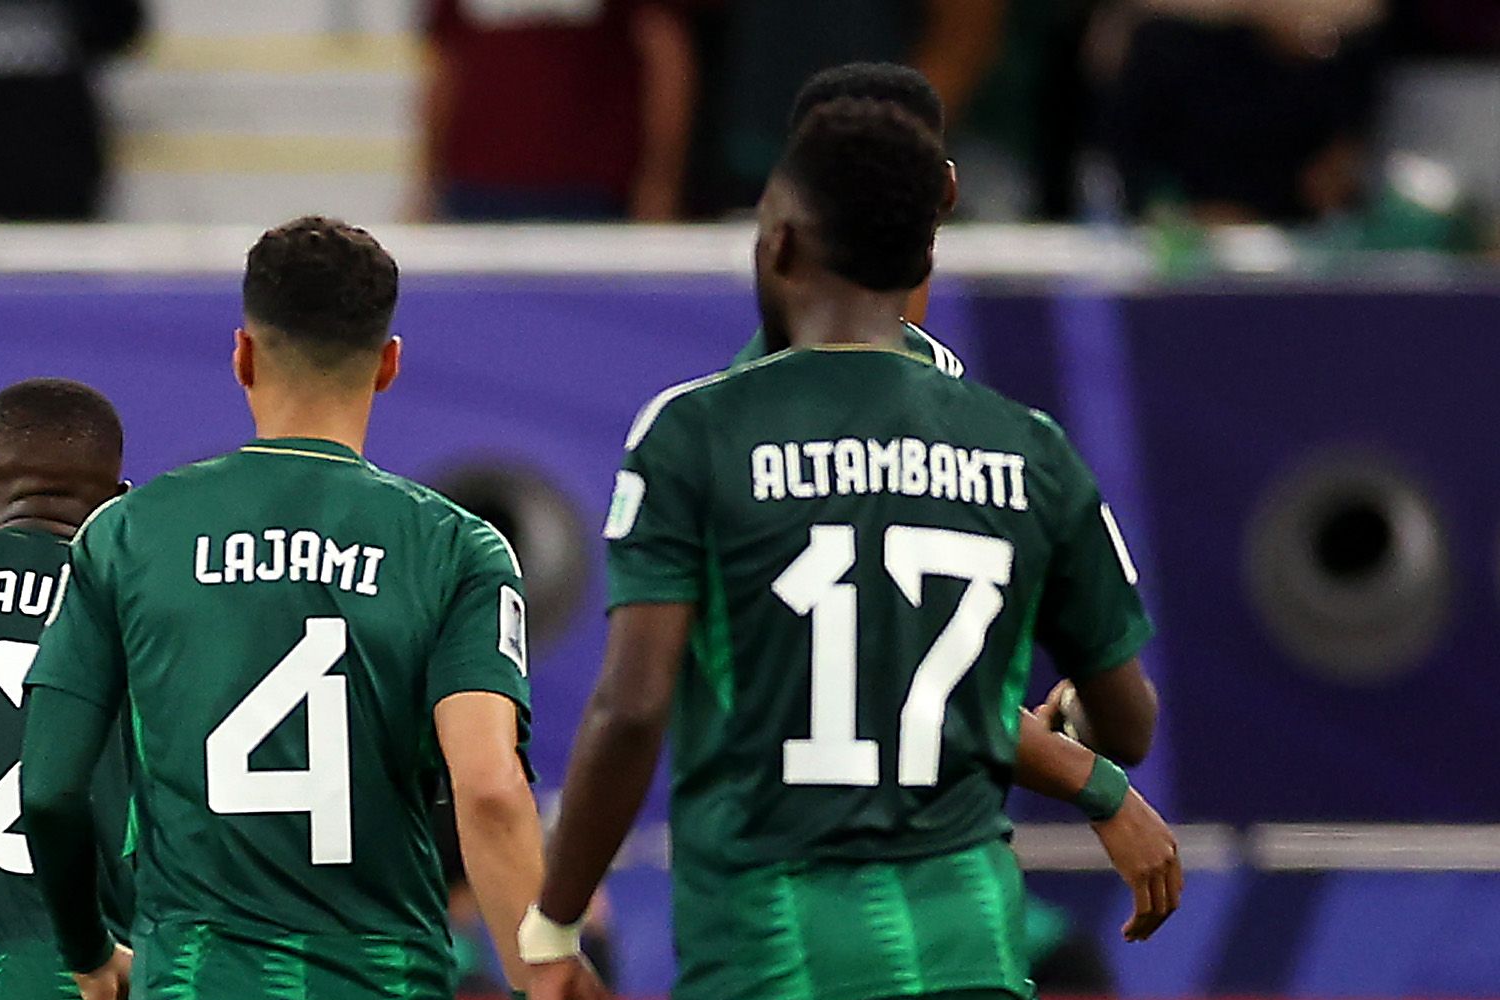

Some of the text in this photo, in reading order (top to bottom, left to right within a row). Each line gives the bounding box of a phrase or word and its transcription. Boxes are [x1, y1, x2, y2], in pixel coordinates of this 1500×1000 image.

[752, 437, 1028, 511] ALTAMBAKTI
[195, 529, 385, 596] LAJAMI
[771, 524, 1014, 786] 17
[206, 618, 352, 865] 4
